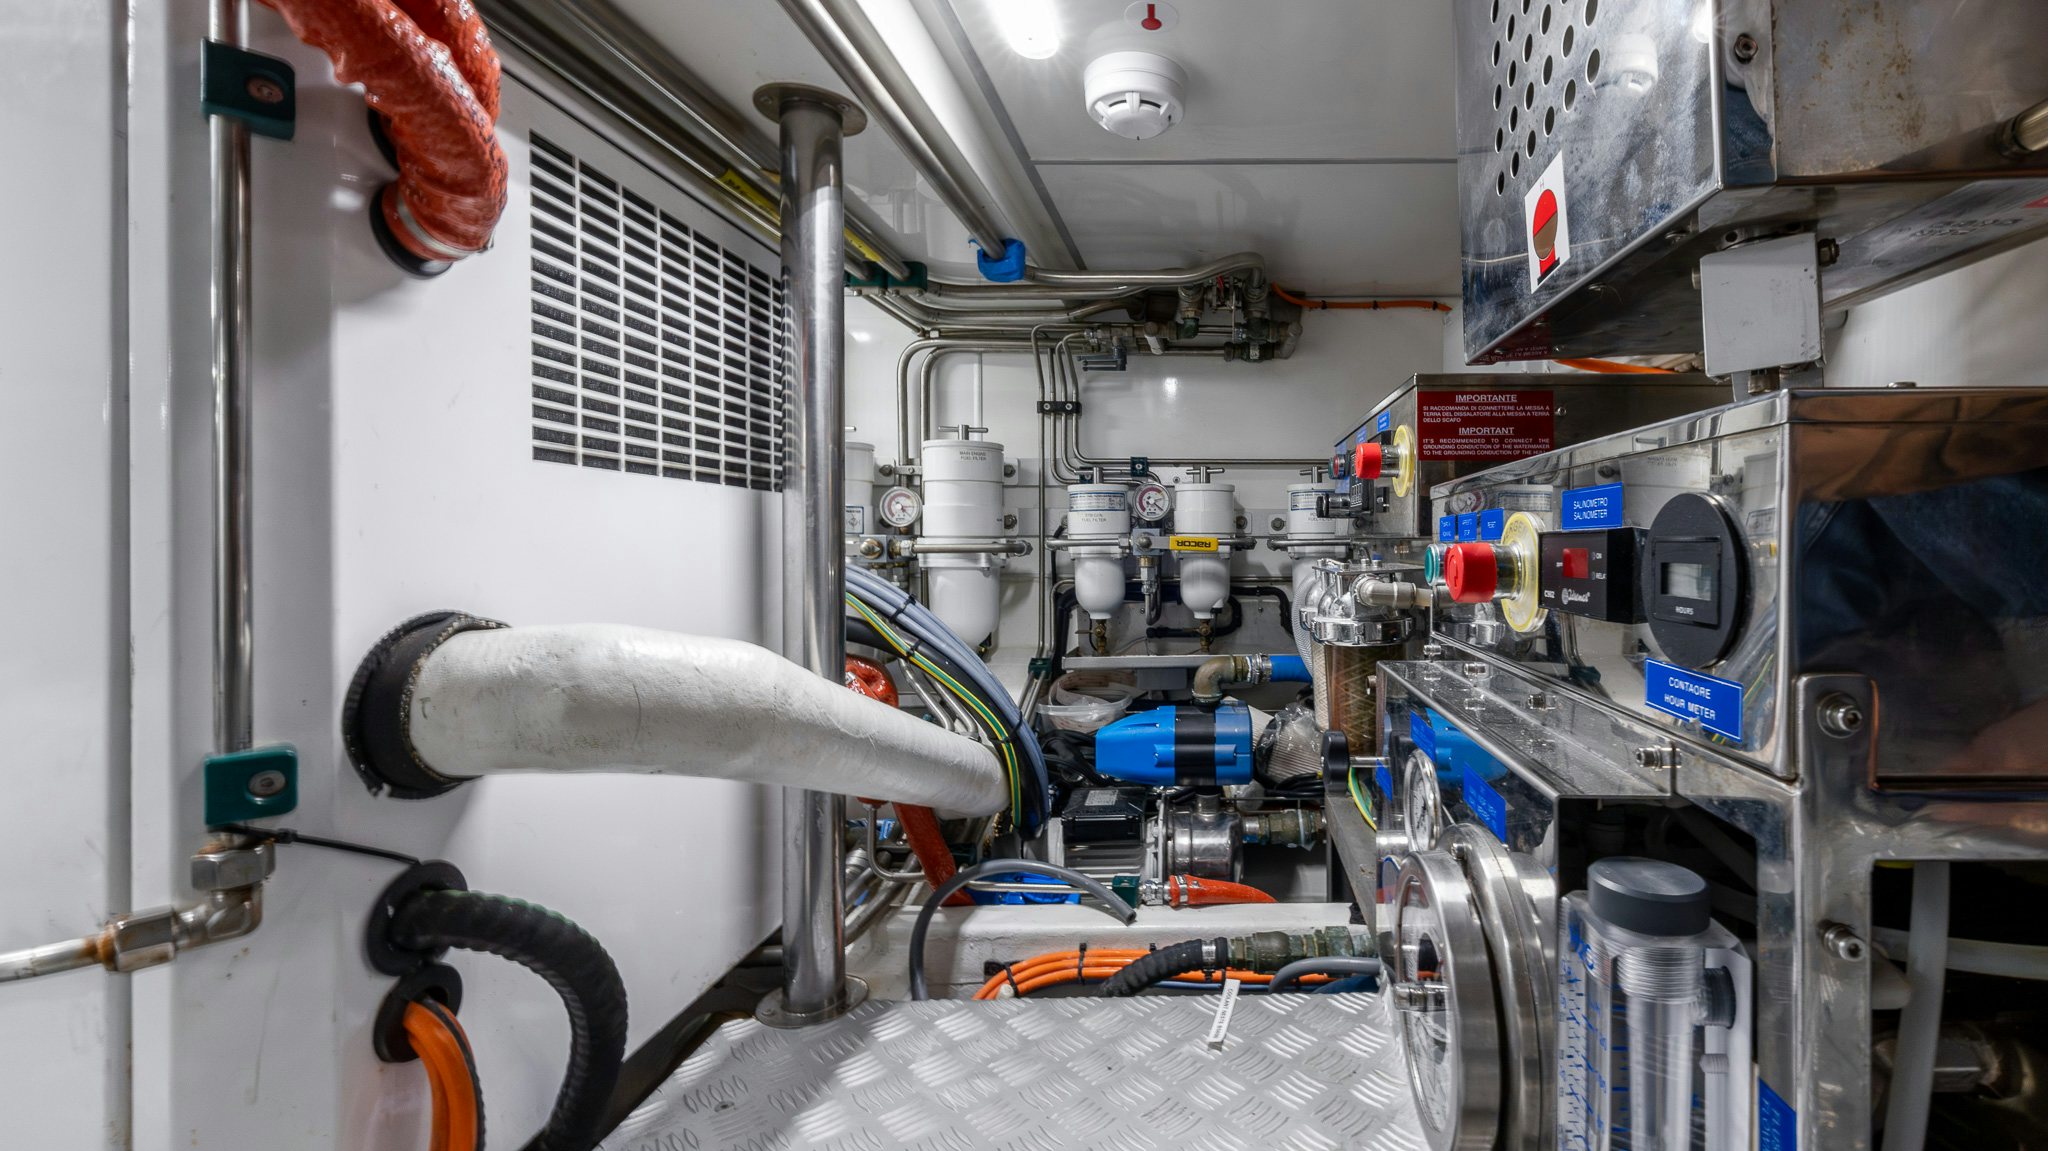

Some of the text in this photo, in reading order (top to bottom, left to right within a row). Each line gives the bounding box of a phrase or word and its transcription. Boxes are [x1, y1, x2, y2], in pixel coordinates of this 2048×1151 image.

[1455, 394, 1518, 402] IMPORTANTE
[1459, 427, 1514, 435] IMPORTANT
[1573, 497, 1608, 510] SALINOMETRO
[1573, 509, 1608, 521] SALINOMETER
[1675, 605, 1694, 616] HOURS
[1668, 676, 1711, 700] CONTAORE
[1664, 693, 1686, 708] HOUR
[1687, 701, 1716, 721] METER
